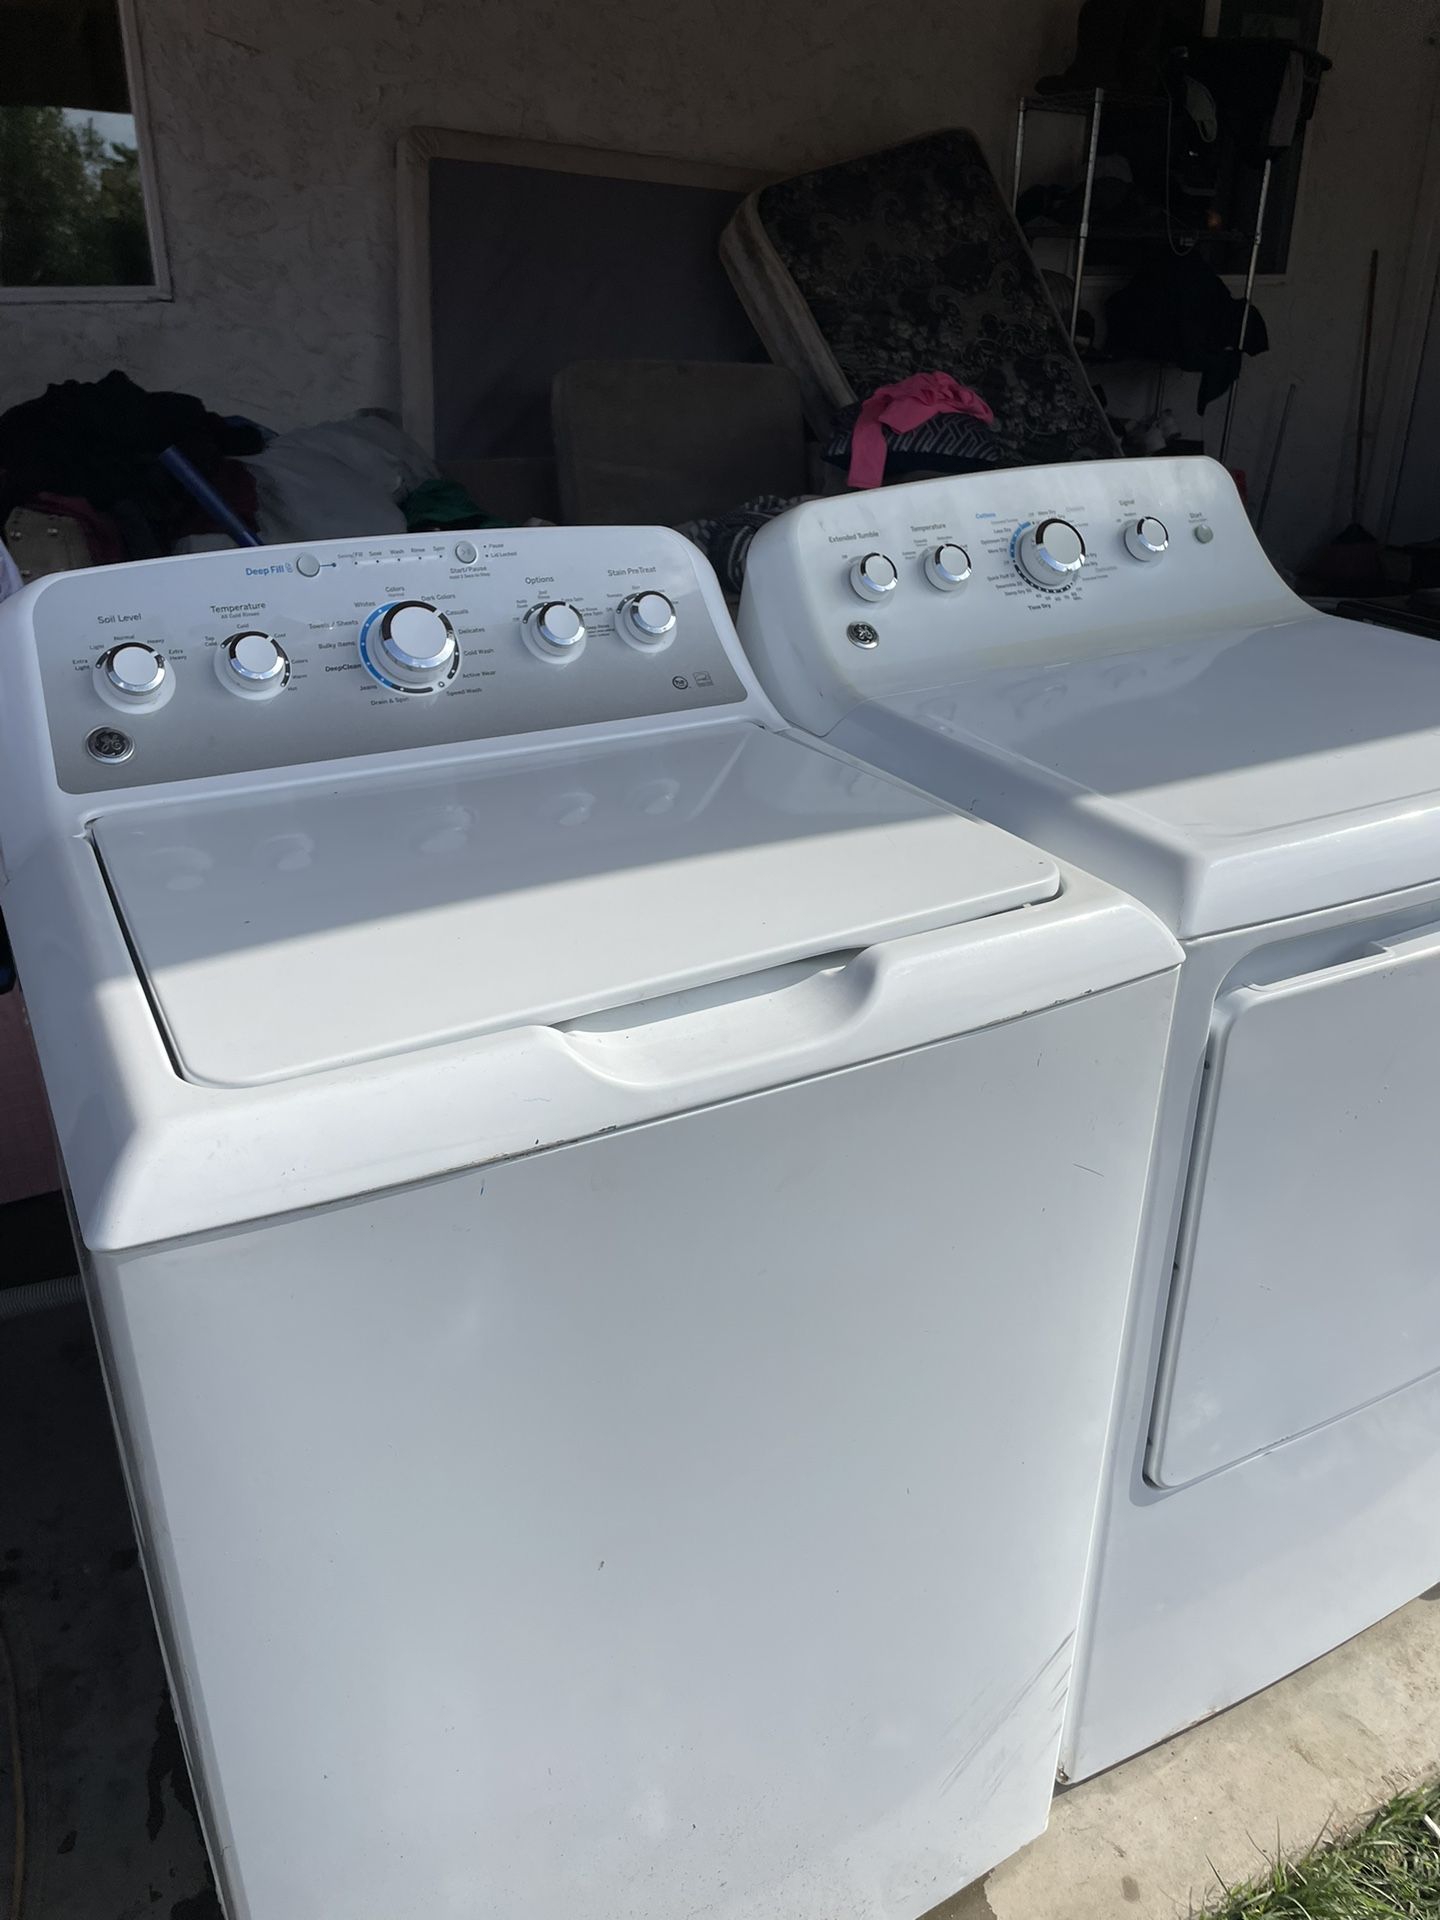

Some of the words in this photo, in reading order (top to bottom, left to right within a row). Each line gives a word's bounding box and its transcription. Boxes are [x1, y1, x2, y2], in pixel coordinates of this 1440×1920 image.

[910, 522, 946, 532] Temperature
[828, 534, 857, 543] Extended
[857, 531, 880, 540] Tumble
[245, 566, 270, 576] Deep
[270, 564, 285, 573] Fill
[607, 569, 627, 577] Stain
[627, 566, 656, 575] PreTreat
[525, 576, 554, 584] Options
[436, 592, 456, 600] Colors
[210, 602, 266, 613] Temperature
[1041, 602, 1051, 610] Dry
[97, 615, 116, 624] Soil
[117, 613, 142, 622] Level
[325, 663, 362, 673] DeepClean
